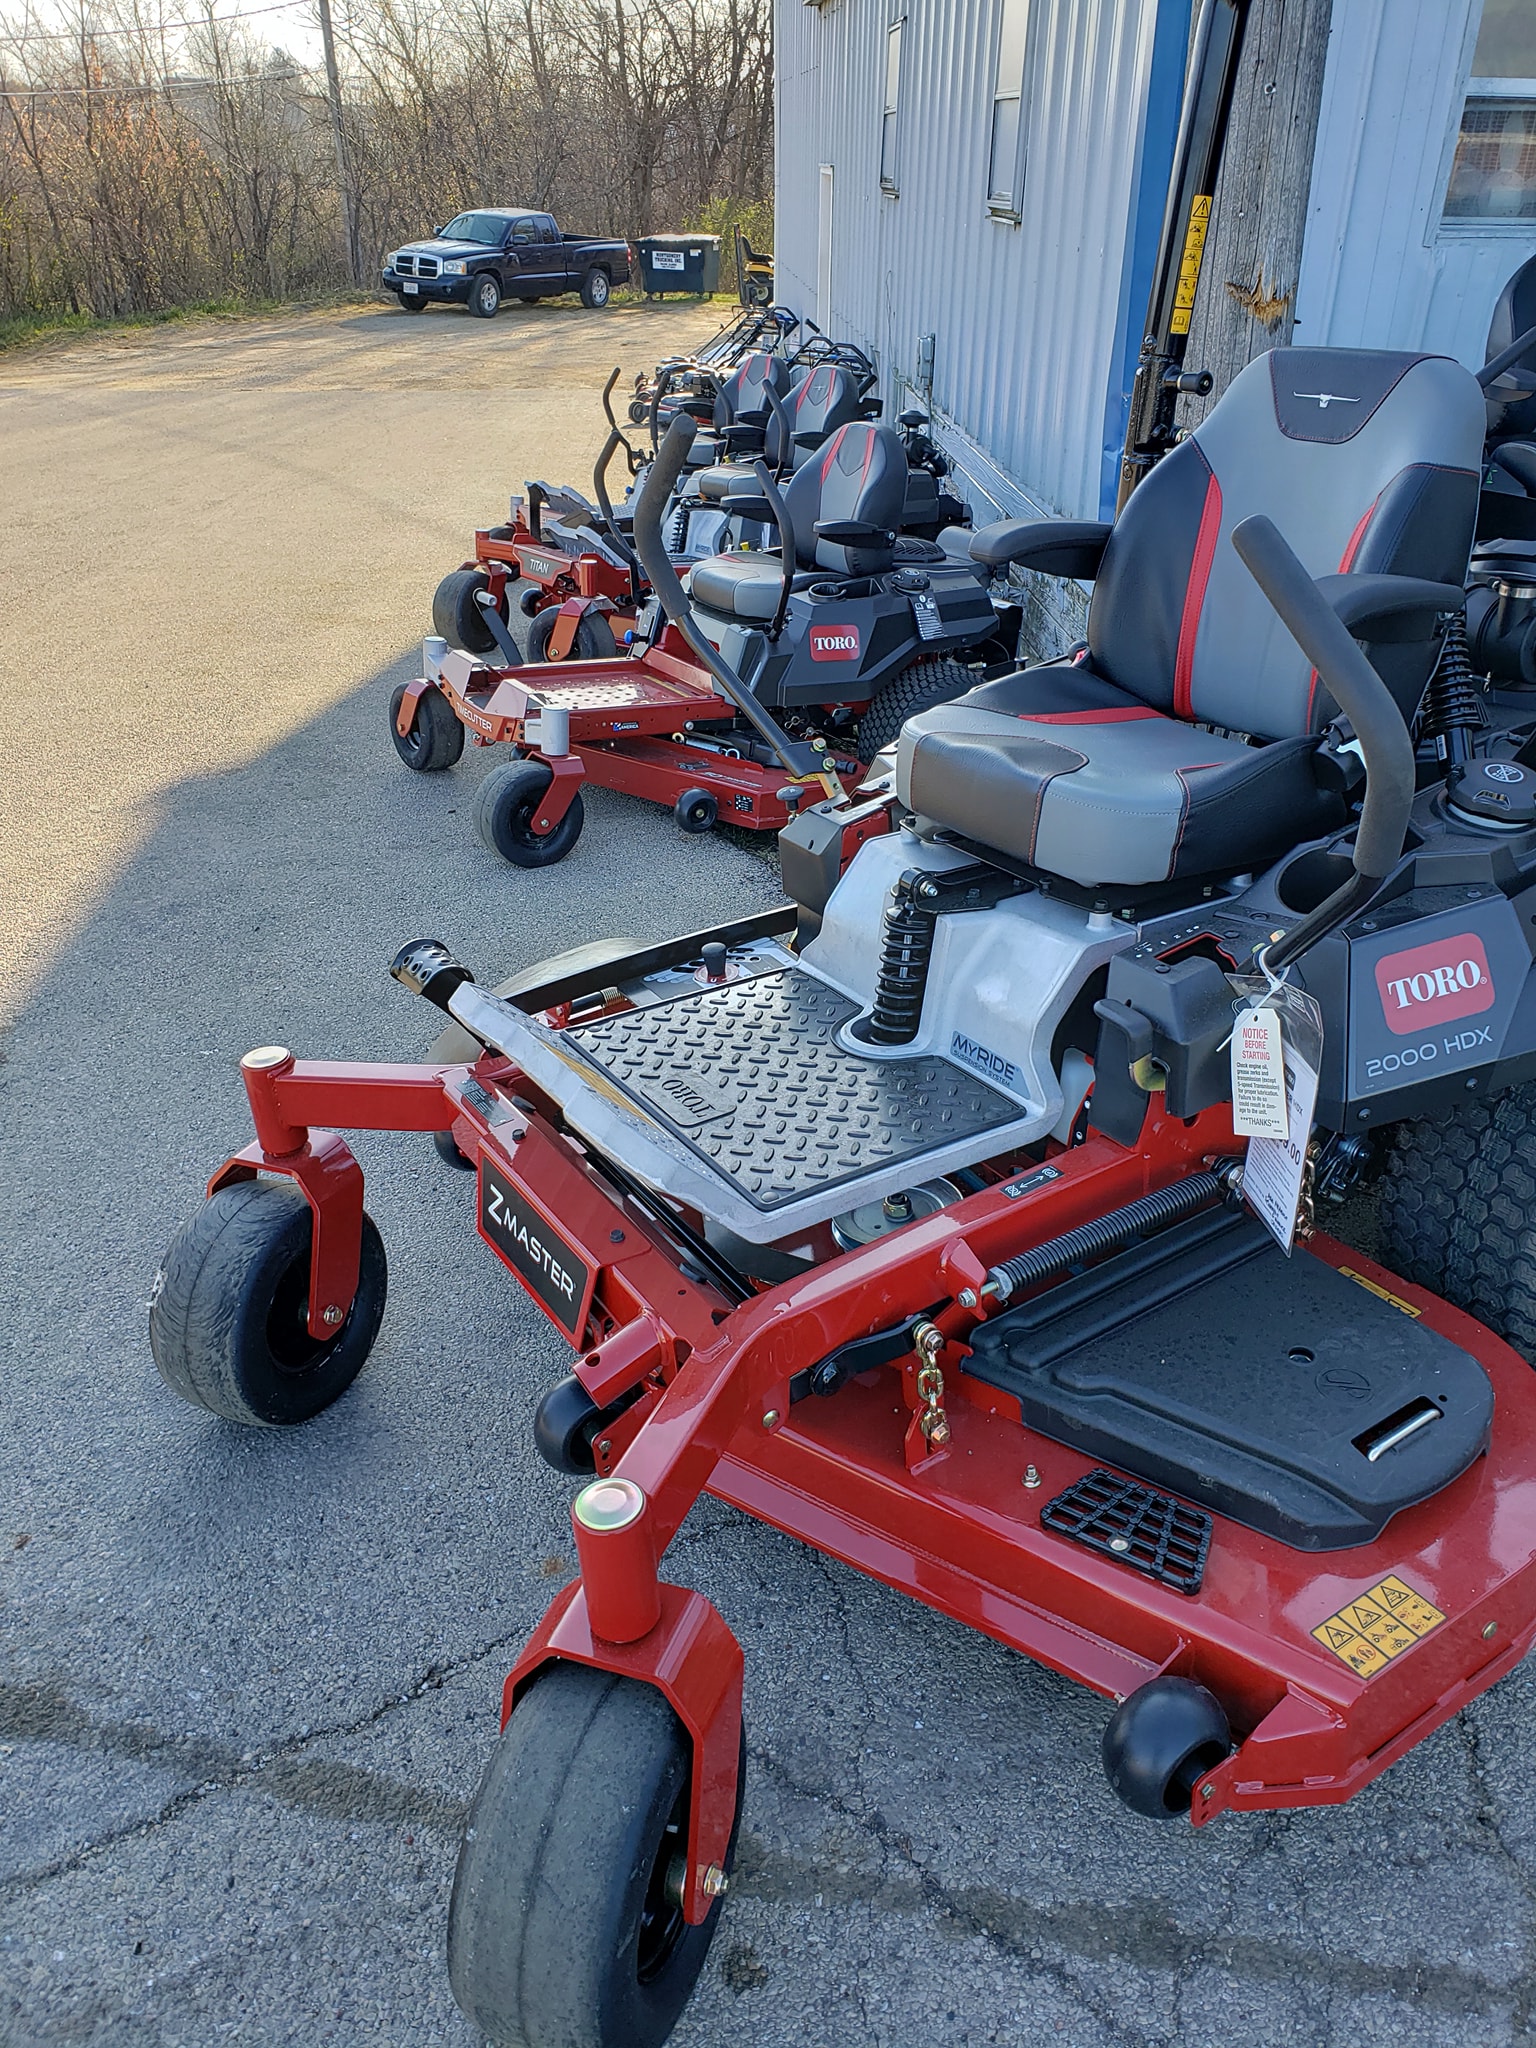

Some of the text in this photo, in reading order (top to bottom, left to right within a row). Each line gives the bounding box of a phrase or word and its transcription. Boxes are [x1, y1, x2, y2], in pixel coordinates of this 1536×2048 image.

[530, 558, 549, 574] TITAN
[456, 702, 492, 732] TIMECUTTER
[1387, 960, 1482, 1009] TORO
[1242, 1028, 1268, 1040] NOTICE
[1244, 1040, 1266, 1049] BEFORE
[1242, 1050, 1270, 1060] STARTING
[1366, 1025, 1493, 1077] 2000 HDX
[953, 1049, 1011, 1086] SUSPENSION SYSTEM
[661, 1079, 716, 1117] TORO
